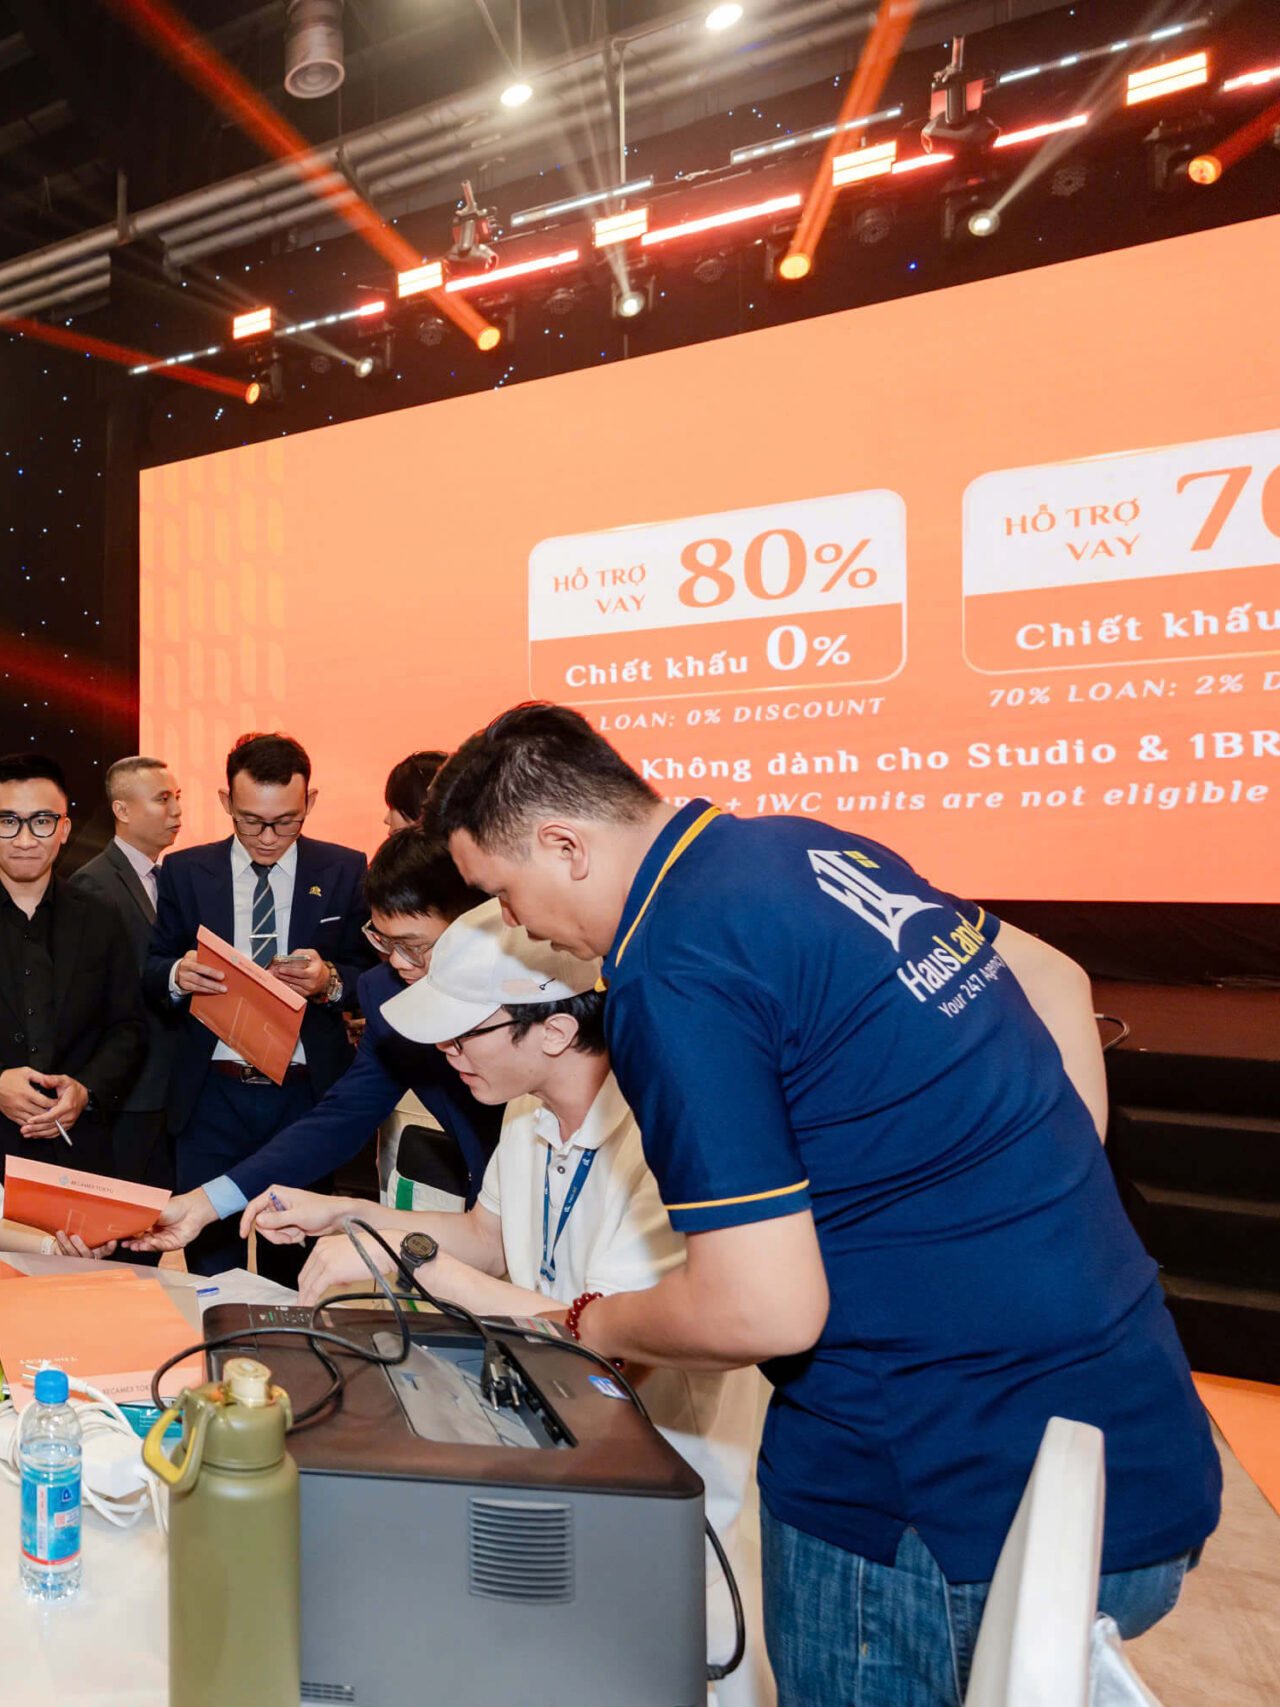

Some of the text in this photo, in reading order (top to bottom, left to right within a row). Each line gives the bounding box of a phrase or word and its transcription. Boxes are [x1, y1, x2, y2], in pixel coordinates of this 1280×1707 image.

[1004, 497, 1141, 537] HỖ TRỢ
[677, 528, 879, 609] 80%
[1064, 534, 1140, 561] VAY
[596, 594, 645, 615] VAY
[1016, 602, 1280, 651] Chiết khấu
[565, 625, 851, 687] Chiết khấu 0%
[989, 686, 1050, 708] 70%
[1068, 679, 1177, 703] LOAN:
[1194, 673, 1244, 695] 2%
[599, 697, 885, 732] LOAN: 0% DISCOUNT
[641, 730, 1280, 783] Không dành cho Studio & 1BR
[757, 791, 823, 814] 1WC
[836, 791, 926, 812] units
[942, 791, 1004, 809] are
[1021, 786, 1086, 807] not
[1103, 780, 1268, 810] eligible
[896, 911, 986, 1002] HausLand
[937, 992, 968, 1018] Your
[960, 973, 986, 1000] 247
